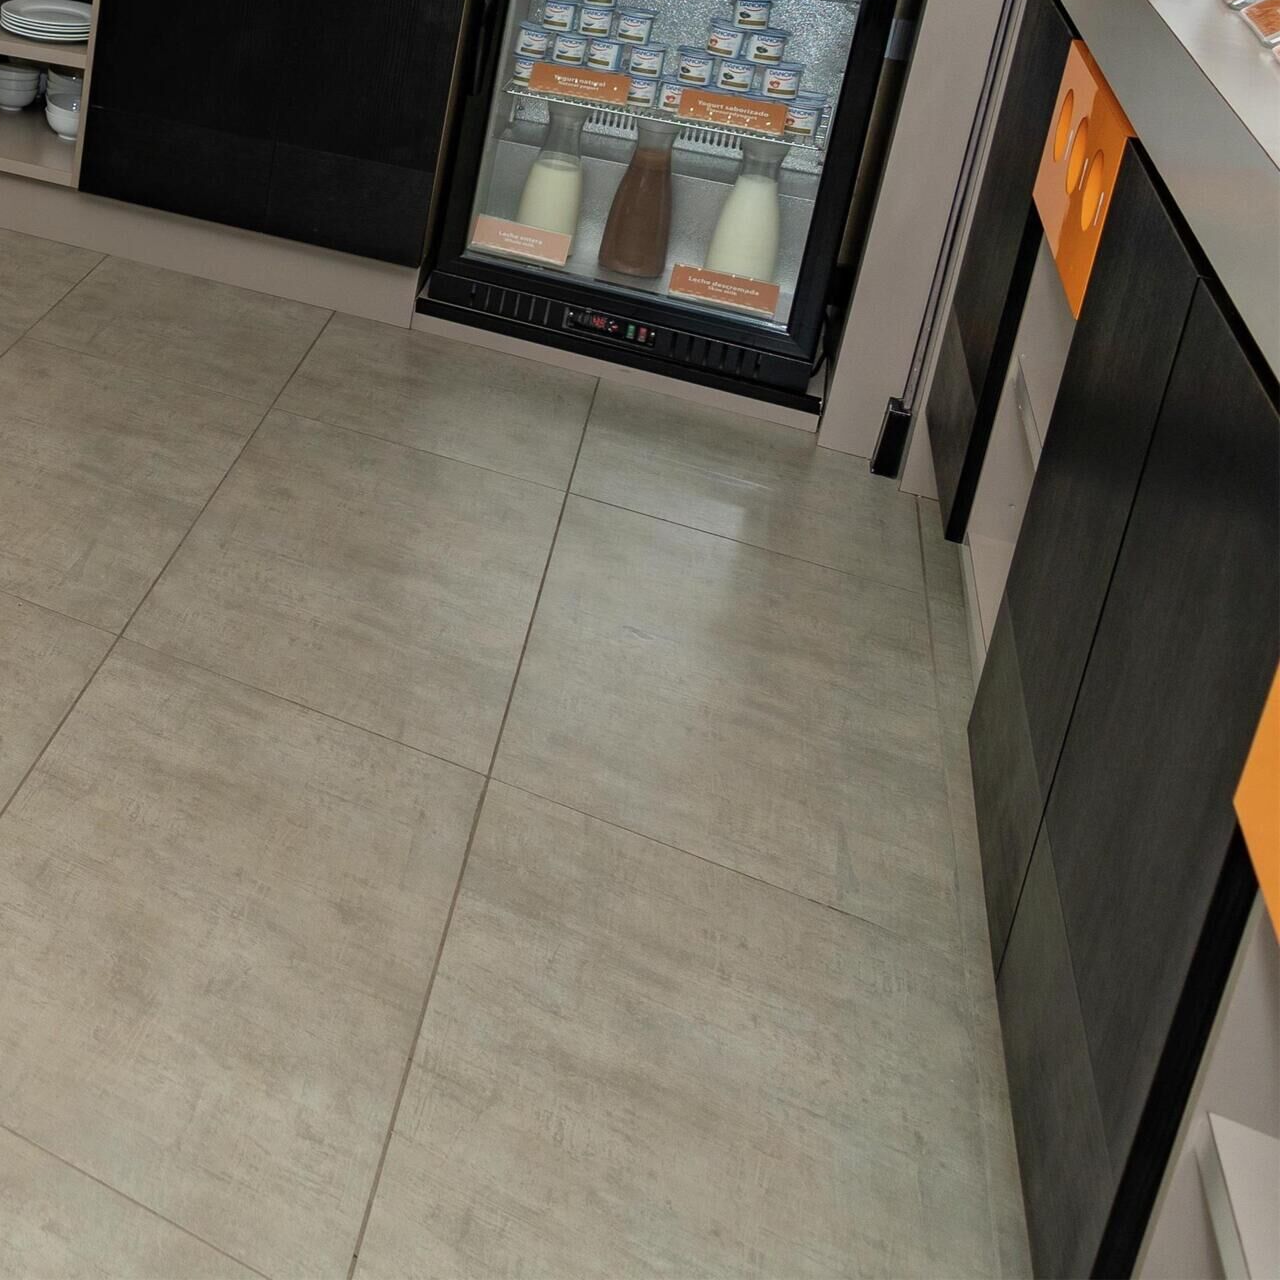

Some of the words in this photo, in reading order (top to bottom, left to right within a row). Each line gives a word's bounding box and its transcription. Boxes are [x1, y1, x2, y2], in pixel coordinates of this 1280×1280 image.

[698, 100, 724, 110] Yogurt
[725, 107, 768, 118] saborizado
[688, 275, 711, 285] Leche
